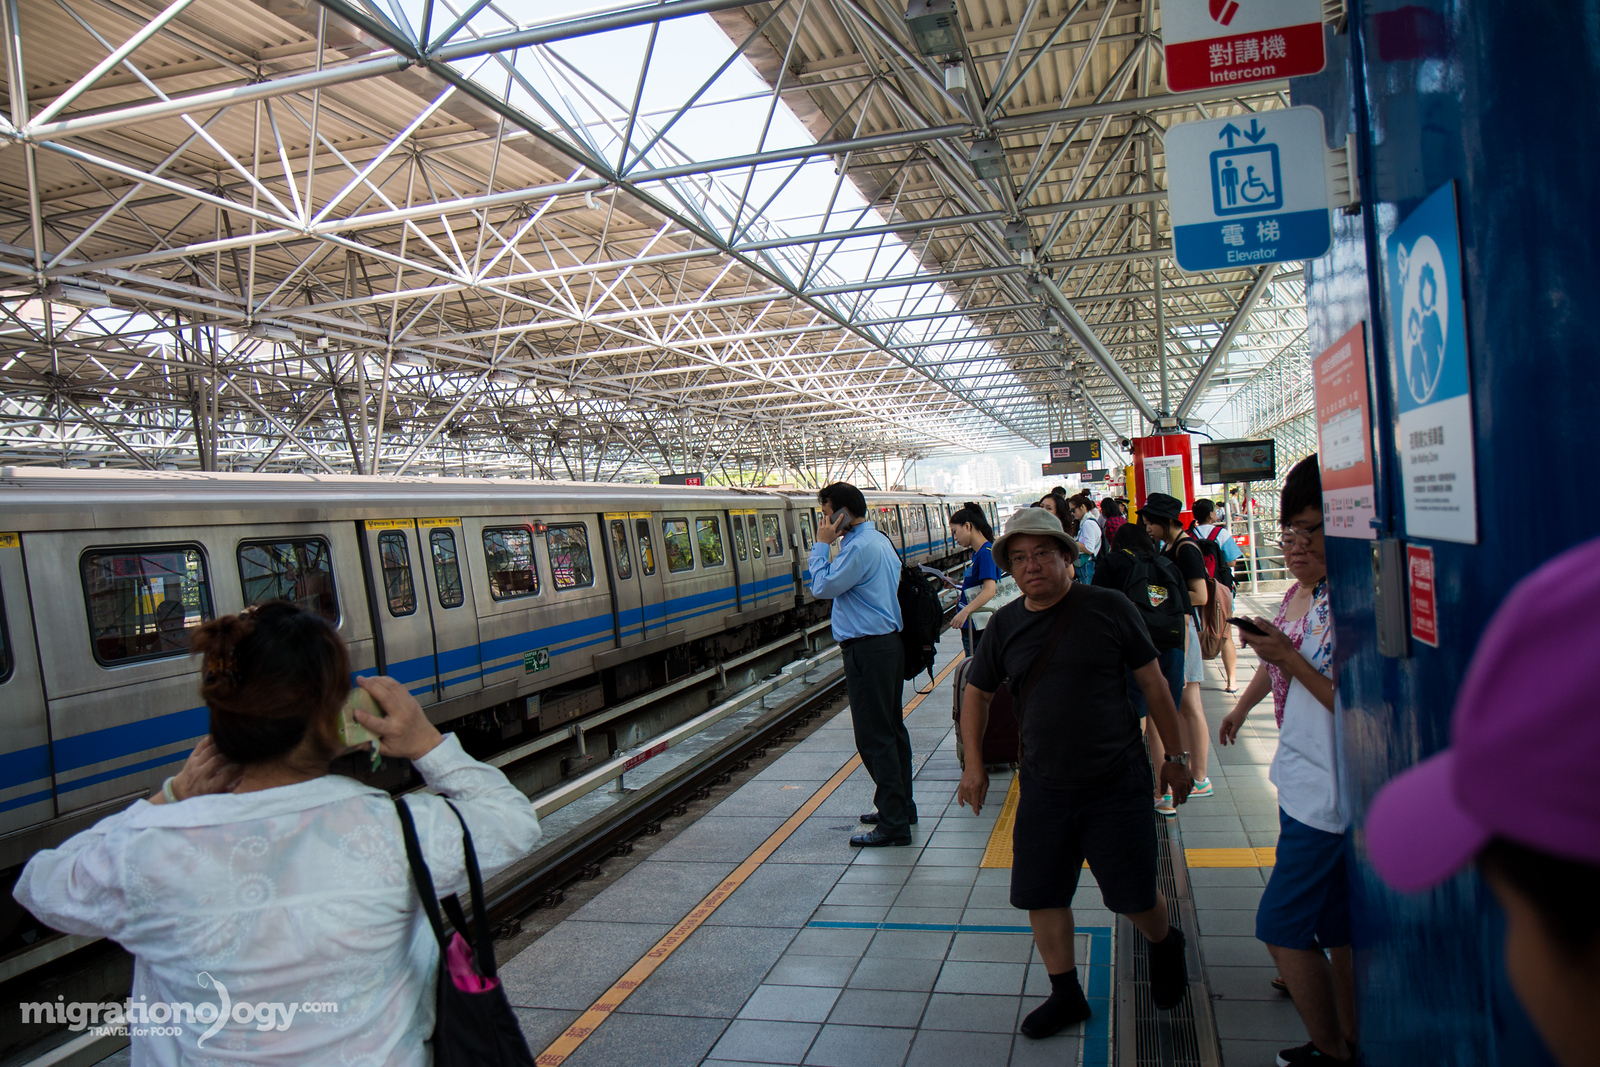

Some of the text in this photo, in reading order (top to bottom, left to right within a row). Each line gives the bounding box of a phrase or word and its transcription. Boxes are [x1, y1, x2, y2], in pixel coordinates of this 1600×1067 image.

[1208, 34, 1287, 68] 對講機
[1209, 63, 1276, 83] Intercom
[1221, 220, 1281, 247] 電梯
[1227, 247, 1277, 262] Elevator
[647, 946, 667, 958] Do
[663, 936, 681, 948] not
